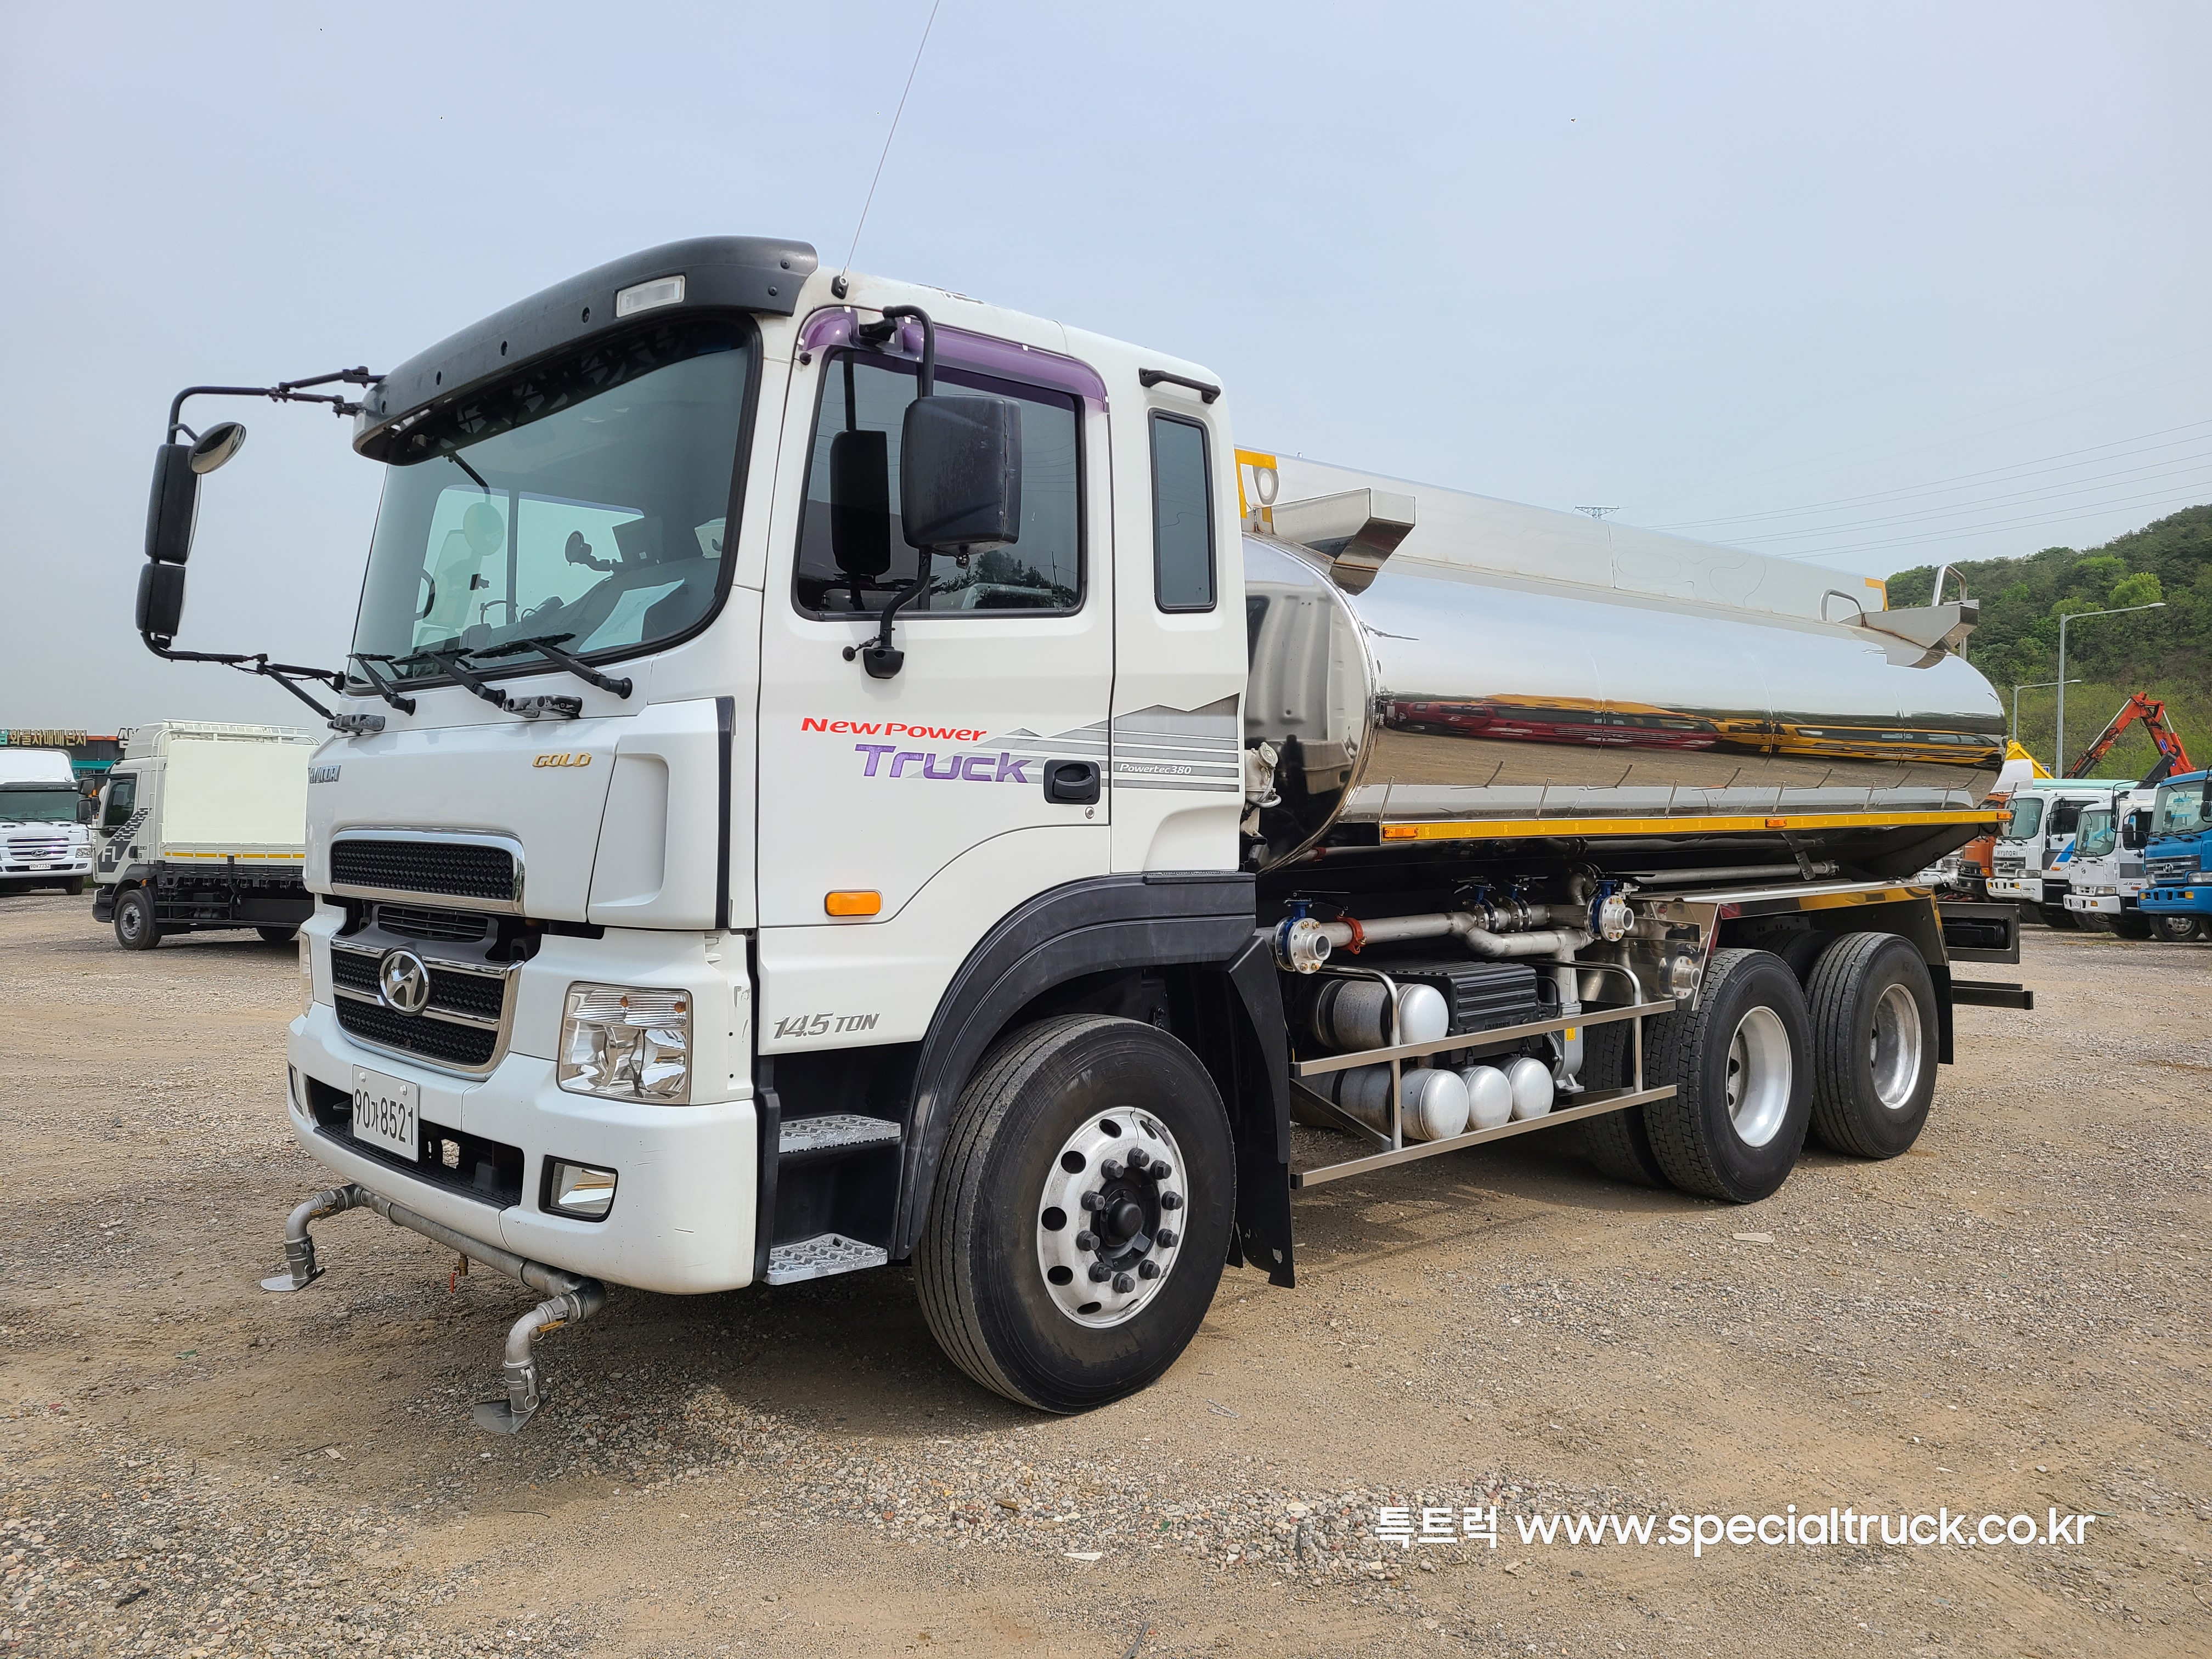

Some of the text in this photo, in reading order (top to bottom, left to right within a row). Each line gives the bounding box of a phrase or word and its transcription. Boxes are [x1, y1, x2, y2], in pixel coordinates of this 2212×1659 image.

[532, 752, 592, 768] GOLD
[854, 743, 1034, 784] Truck
[101, 845, 121, 862] FL
[774, 1012, 881, 1039] 14.5 TON
[354, 1088, 413, 1146] 90가8521
